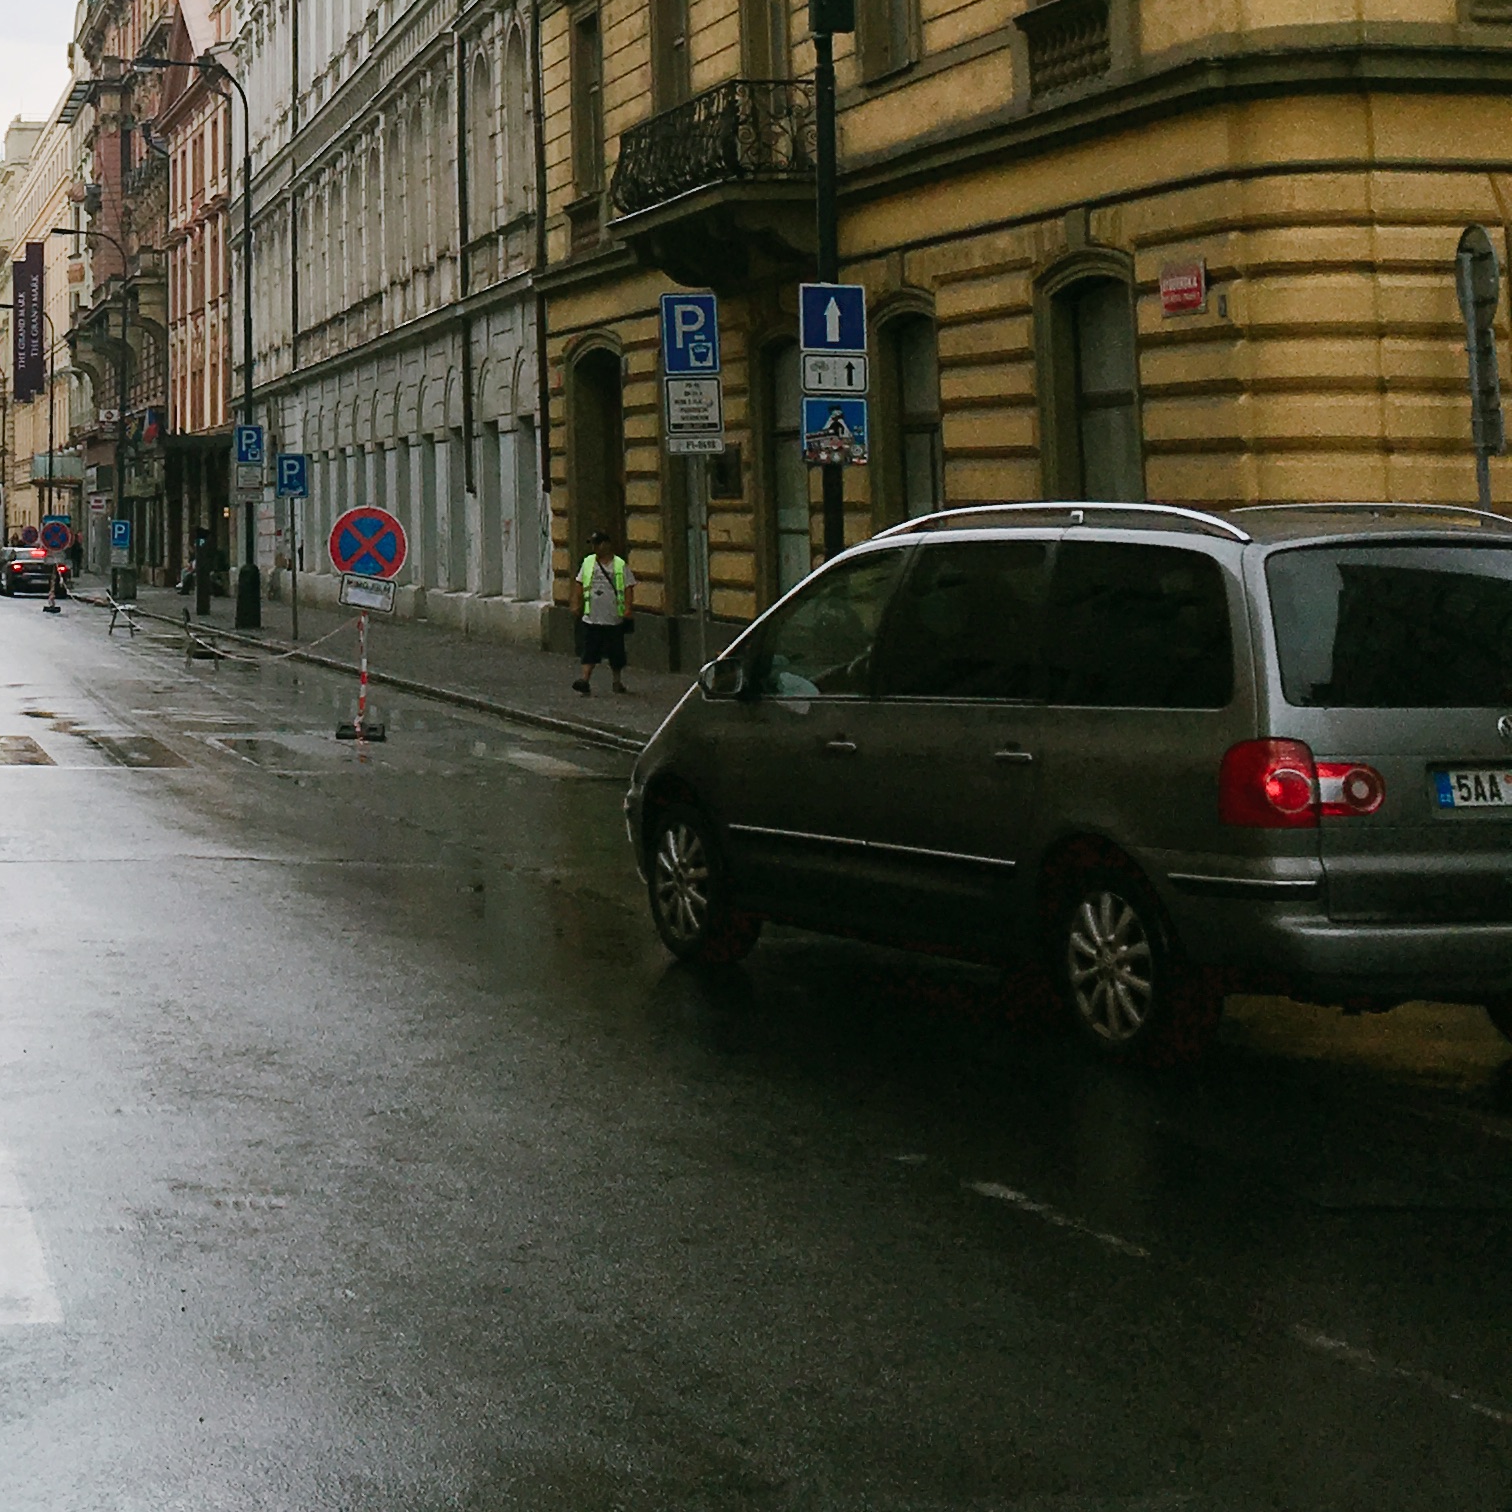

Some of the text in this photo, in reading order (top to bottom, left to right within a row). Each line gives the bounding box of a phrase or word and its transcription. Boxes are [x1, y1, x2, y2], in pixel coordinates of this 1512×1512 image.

[675, 304, 705, 349] P
[18, 352, 26, 370] THE
[242, 430, 257, 451] P
[282, 459, 300, 485] P
[114, 525, 126, 539] P
[1456, 773, 1503, 802] 5AA
